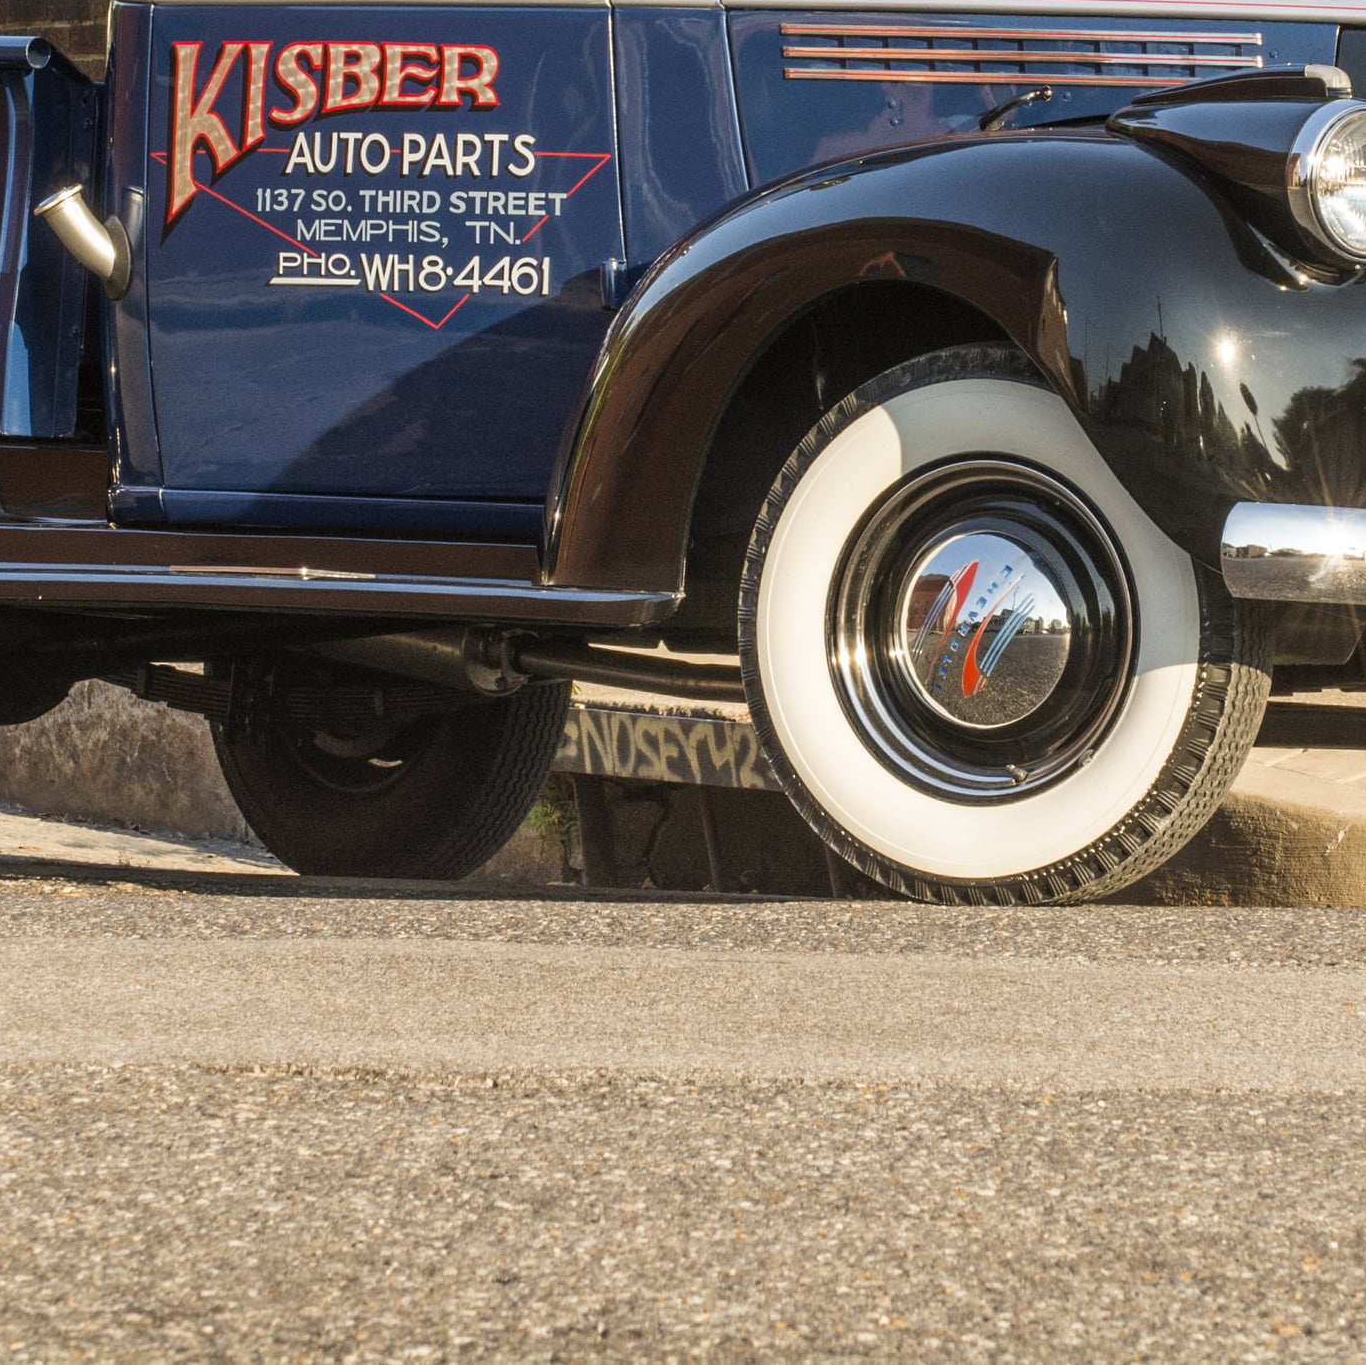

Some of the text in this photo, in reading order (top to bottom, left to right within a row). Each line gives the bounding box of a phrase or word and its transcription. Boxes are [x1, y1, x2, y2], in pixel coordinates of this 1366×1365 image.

[168, 41, 501, 226] KISBER
[285, 132, 536, 177] AUTO PARTS
[256, 188, 568, 216] 1137 SO. THIRD STREET
[297, 219, 521, 248] MEMPHIS, TN.
[278, 252, 356, 276] PHO.
